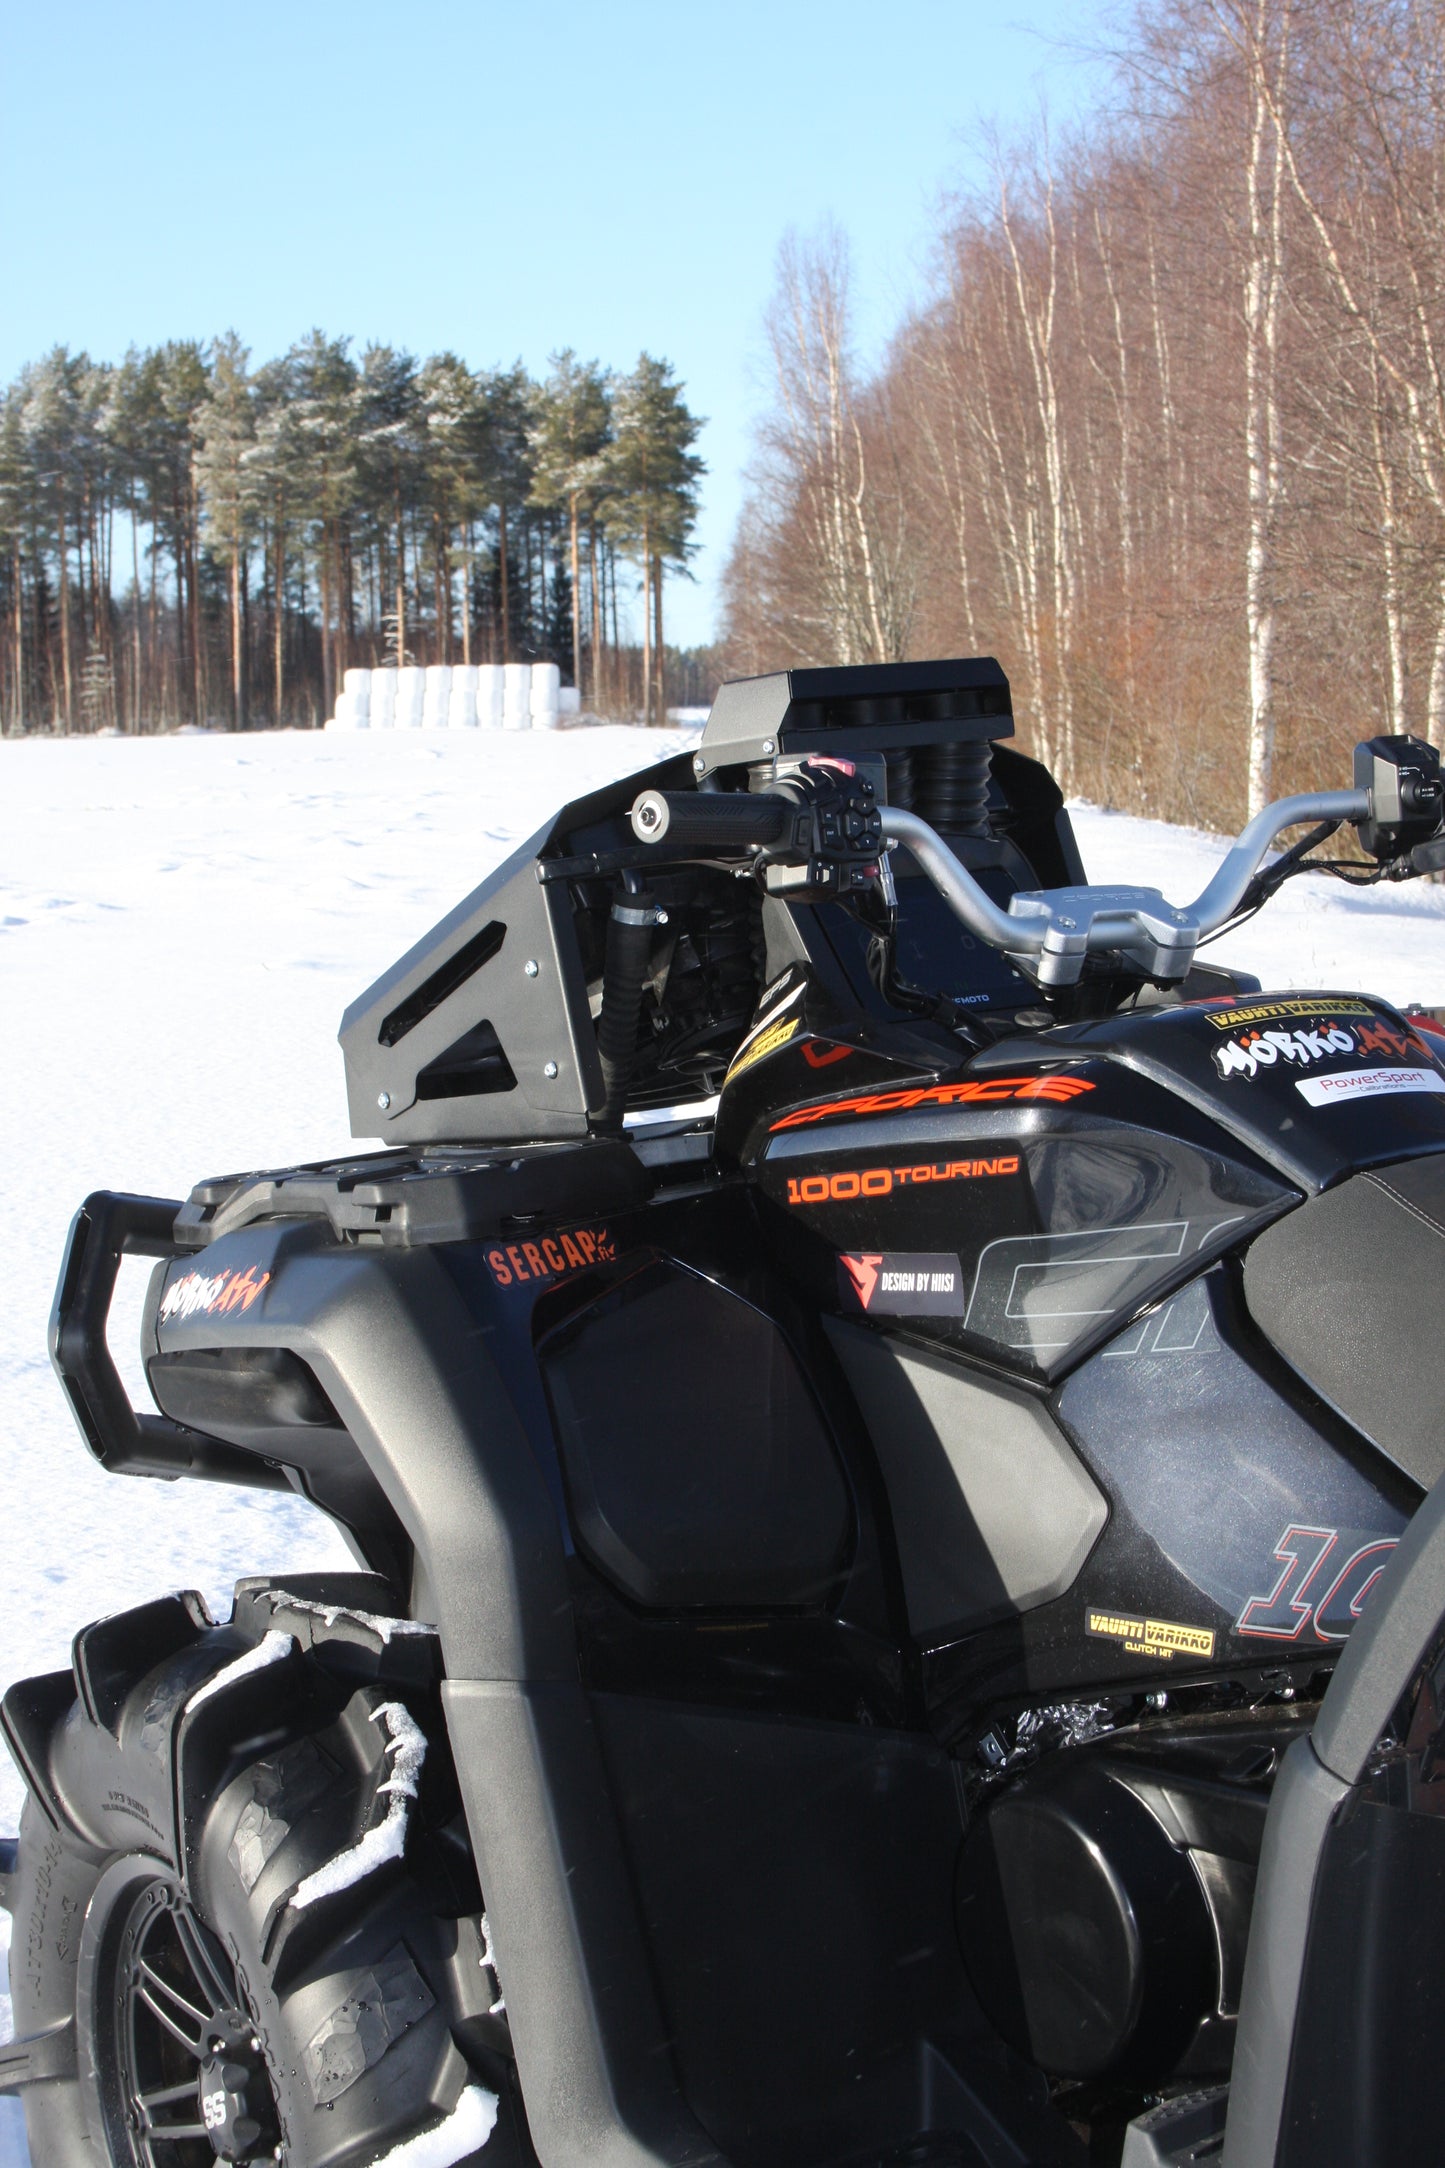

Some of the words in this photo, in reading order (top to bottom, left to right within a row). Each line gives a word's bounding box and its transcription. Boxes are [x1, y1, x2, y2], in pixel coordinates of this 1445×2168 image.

[1213, 1003, 1287, 1026] VAUHTI
[1288, 1000, 1367, 1013] VARIKKO
[1319, 1071, 1425, 1091] PowerSport
[1359, 1083, 1407, 1092] Calibrations
[769, 1076, 1096, 1131] CFORCE
[788, 1168, 892, 1204] 1000
[894, 1156, 1019, 1183] TOURING
[881, 1272, 915, 1291] DESIGN
[916, 1273, 930, 1291] BY
[931, 1273, 955, 1292] HIISI
[1090, 1614, 1145, 1639] VAUHTI
[1146, 1625, 1211, 1650] VARIKKO
[1124, 1641, 1157, 1656] CLUTCH
